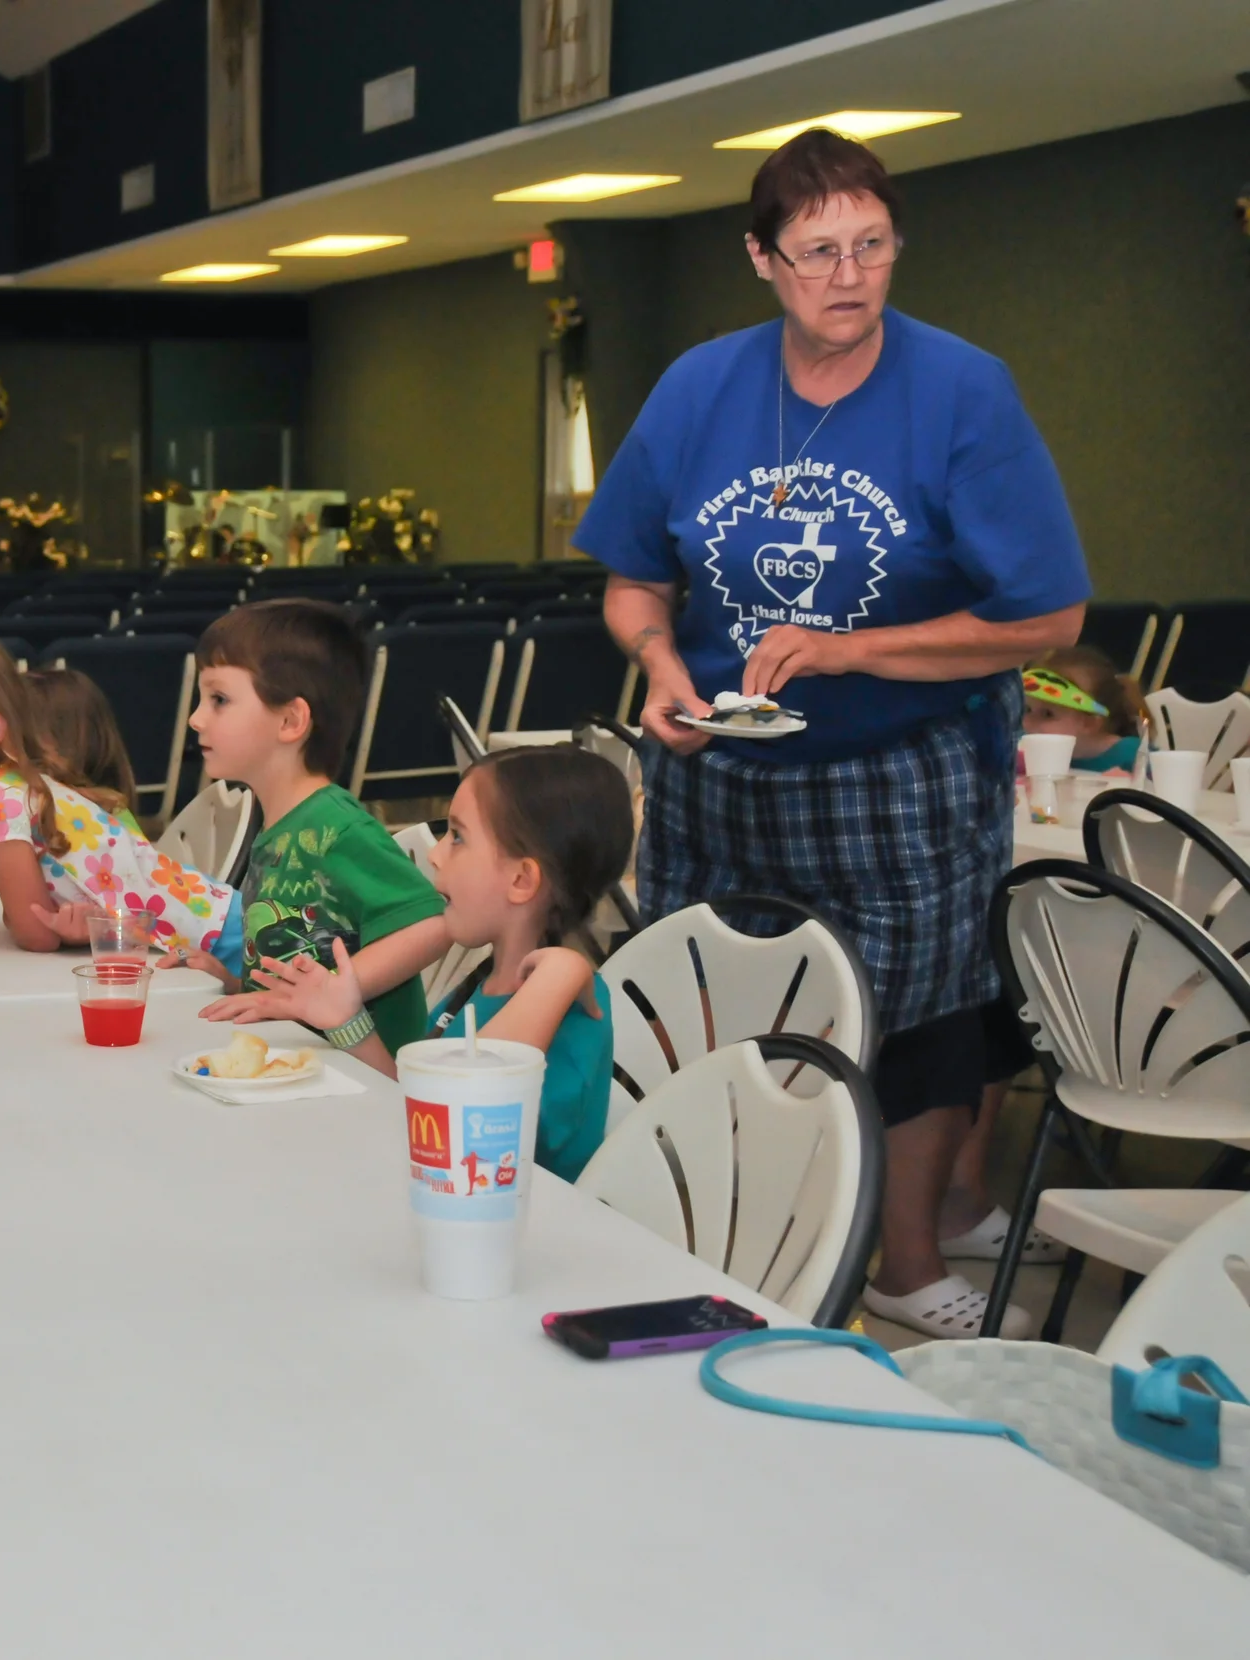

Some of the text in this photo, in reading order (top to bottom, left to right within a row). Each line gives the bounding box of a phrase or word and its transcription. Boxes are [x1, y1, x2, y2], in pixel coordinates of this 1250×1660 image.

[696, 457, 908, 537] First Baptist Church
[760, 505, 836, 524] A Church
[762, 558, 817, 580] FBCS
[751, 604, 833, 627] that loves
